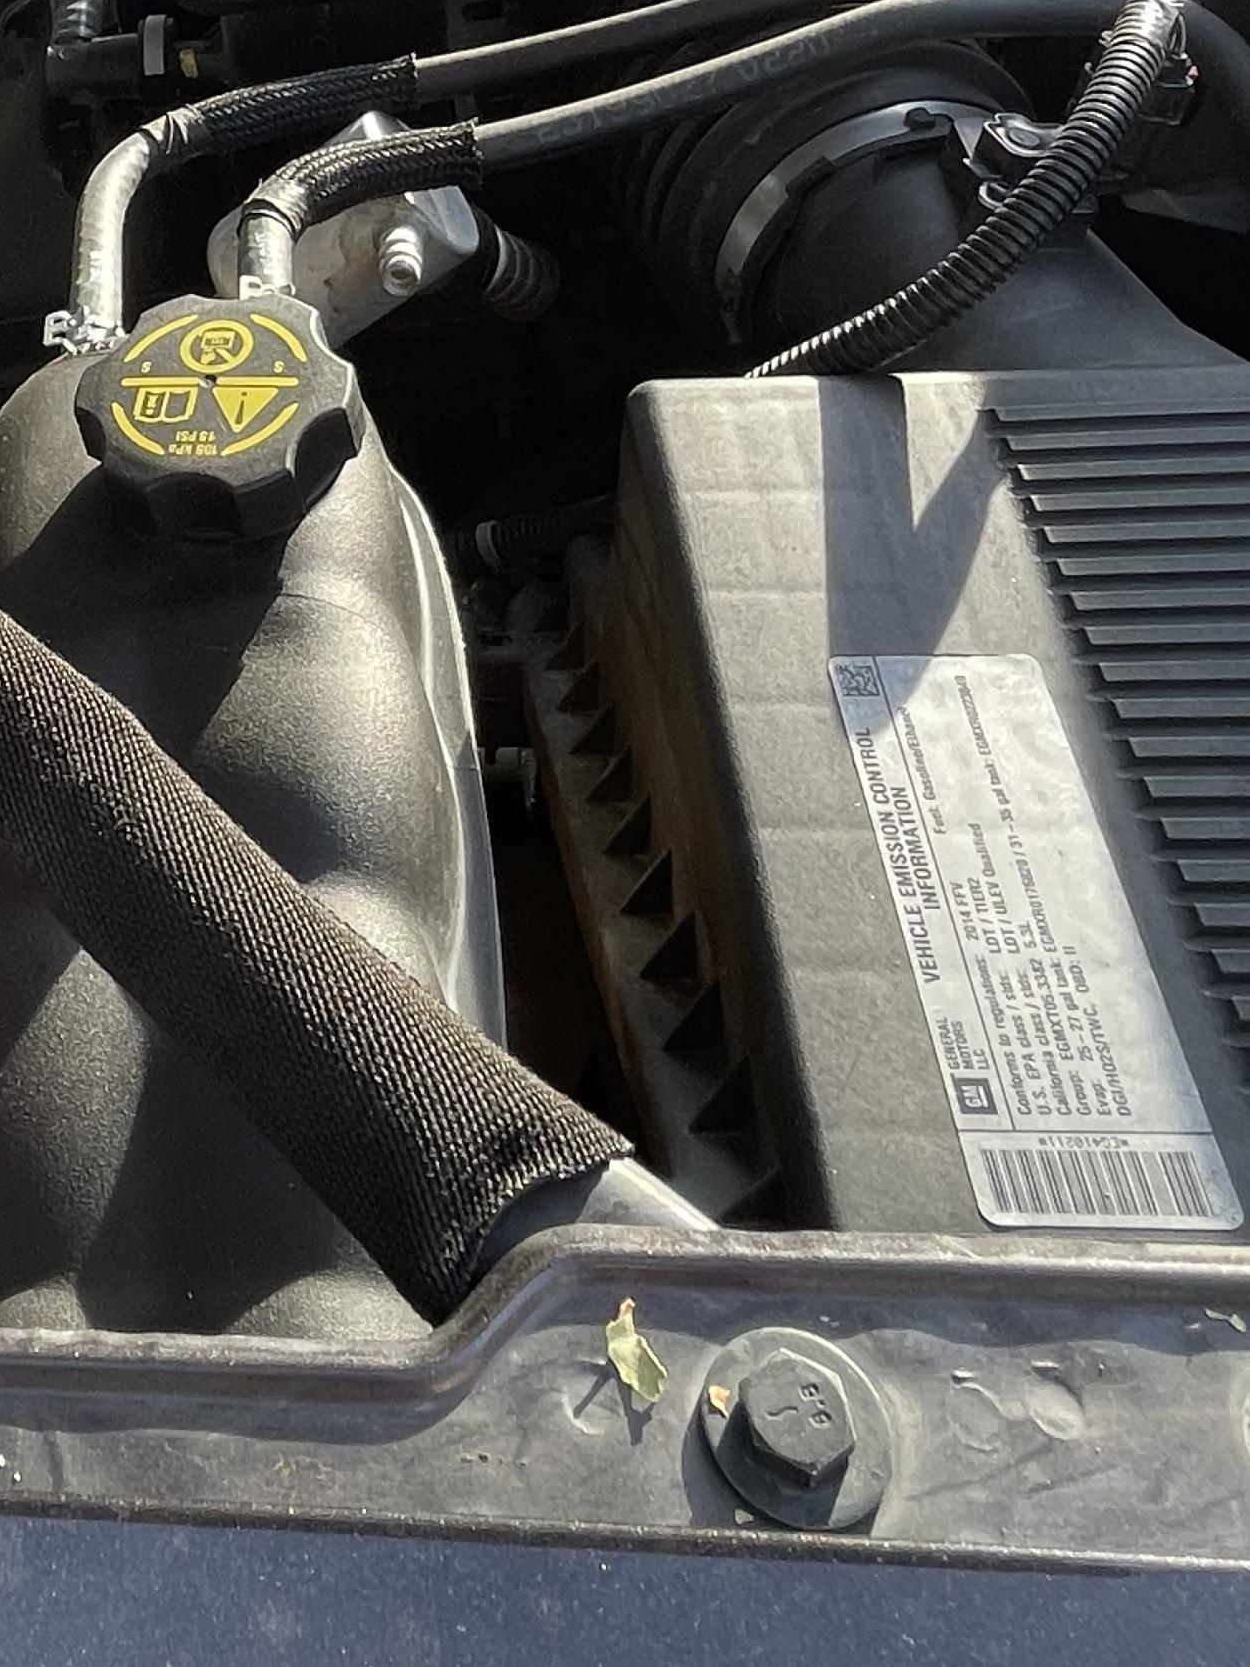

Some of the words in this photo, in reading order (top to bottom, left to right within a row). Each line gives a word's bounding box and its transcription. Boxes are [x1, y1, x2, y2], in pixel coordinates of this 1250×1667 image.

[176, 431, 197, 441] PSI
[852, 726, 890, 804] CONTROL
[876, 810, 917, 897] EMISSION
[889, 785, 942, 910] INFORMATION
[966, 822, 997, 877] Qualified
[948, 881, 969, 906] FFV
[965, 876, 990, 913] TIER2
[985, 881, 1008, 914] ULEV
[957, 910, 980, 941] 2014
[902, 904, 942, 983] VEHICLE
[1057, 991, 1080, 1010] gal
[995, 1033, 1012, 1046] to
[1008, 1013, 1032, 1048] class
[1026, 1012, 1051, 1046] class
[1065, 1015, 1084, 1031] 27
[933, 1016, 961, 1069] GENERAL
[949, 1021, 975, 1069] MOTORS
[971, 1047, 990, 1069] LLC
[1075, 1045, 1094, 1060] 25
[999, 1050, 1032, 1115] Conforms
[1020, 1053, 1042, 1080] EPA
[1038, 1049, 1072, 1115] California
[1029, 1086, 1052, 1114] U.S.
[1063, 1070, 1095, 1115] Group:
